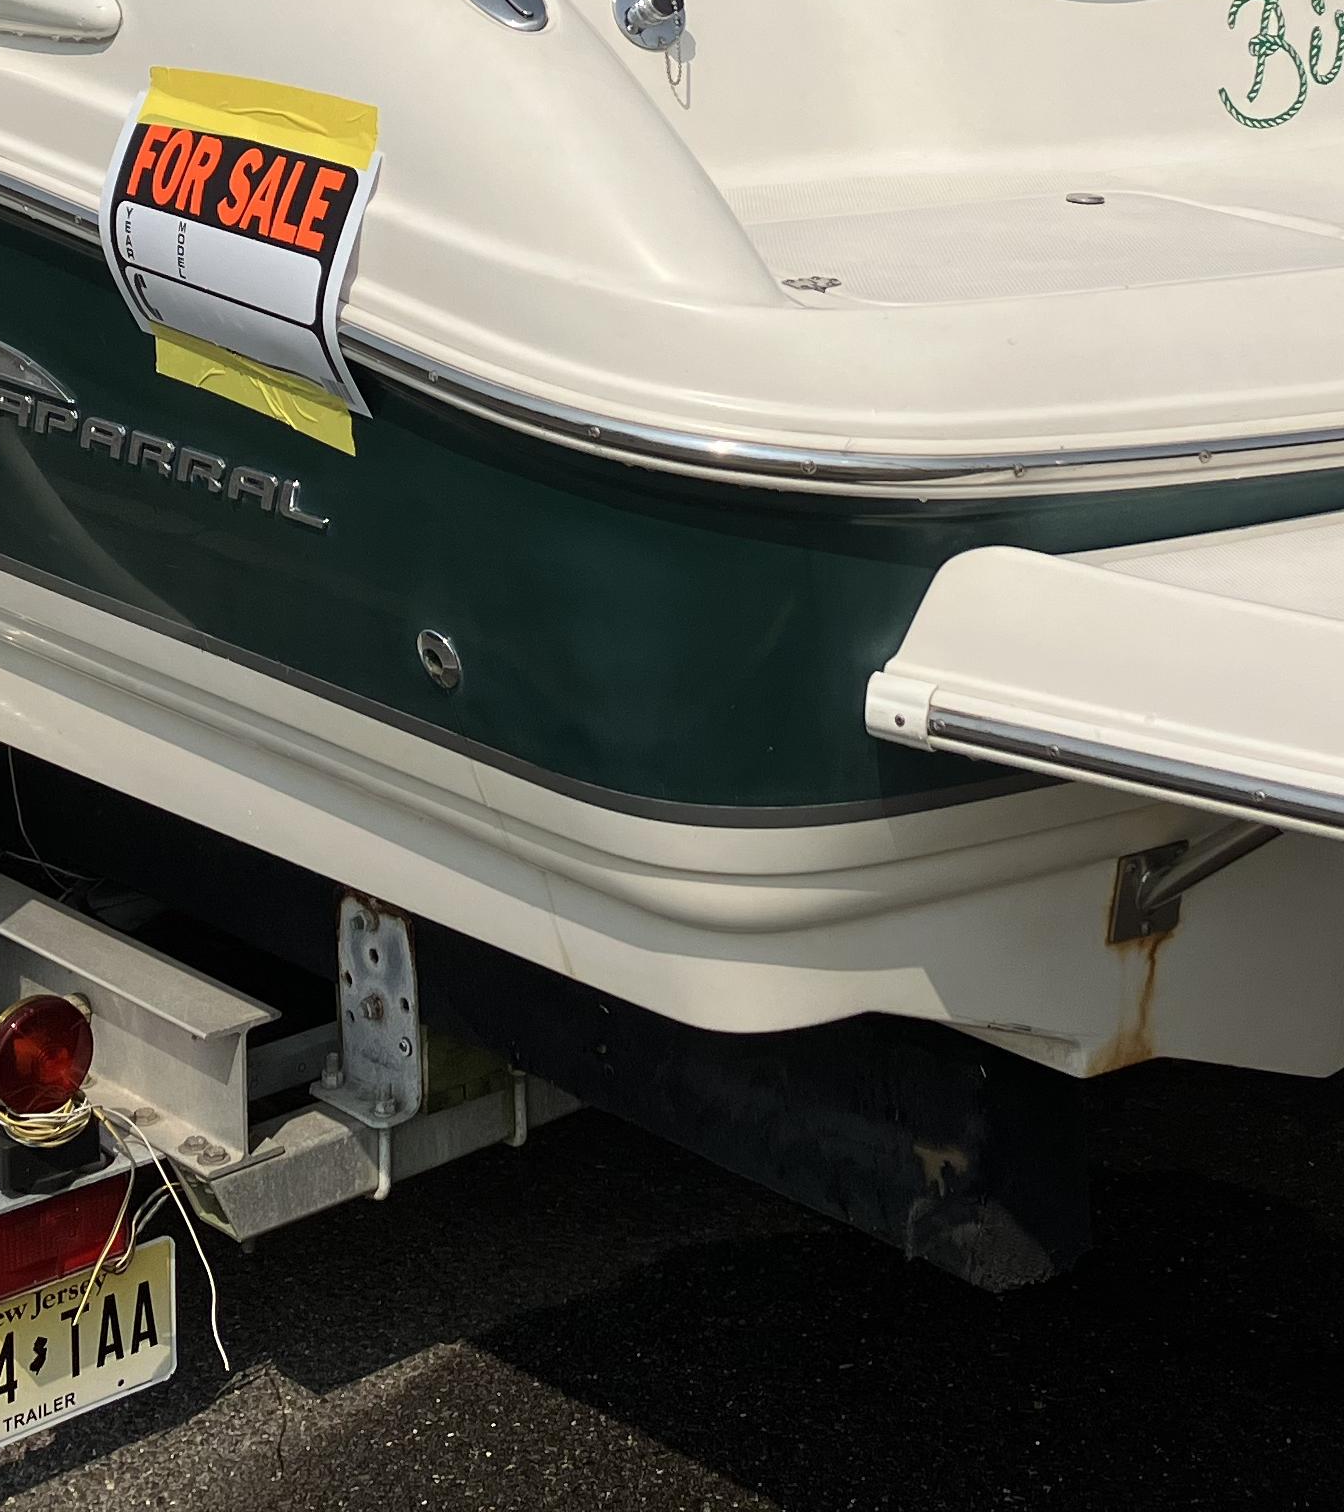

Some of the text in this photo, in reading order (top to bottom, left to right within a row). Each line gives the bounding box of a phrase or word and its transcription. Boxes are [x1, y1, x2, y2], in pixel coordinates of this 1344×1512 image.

[126, 124, 347, 253] FOR SALE
[124, 206, 188, 280] YEAR MODEL
[30, 1271, 107, 1320] Jersey
[60, 1280, 159, 1378] TAA
[3, 1392, 76, 1433] TRAILER
